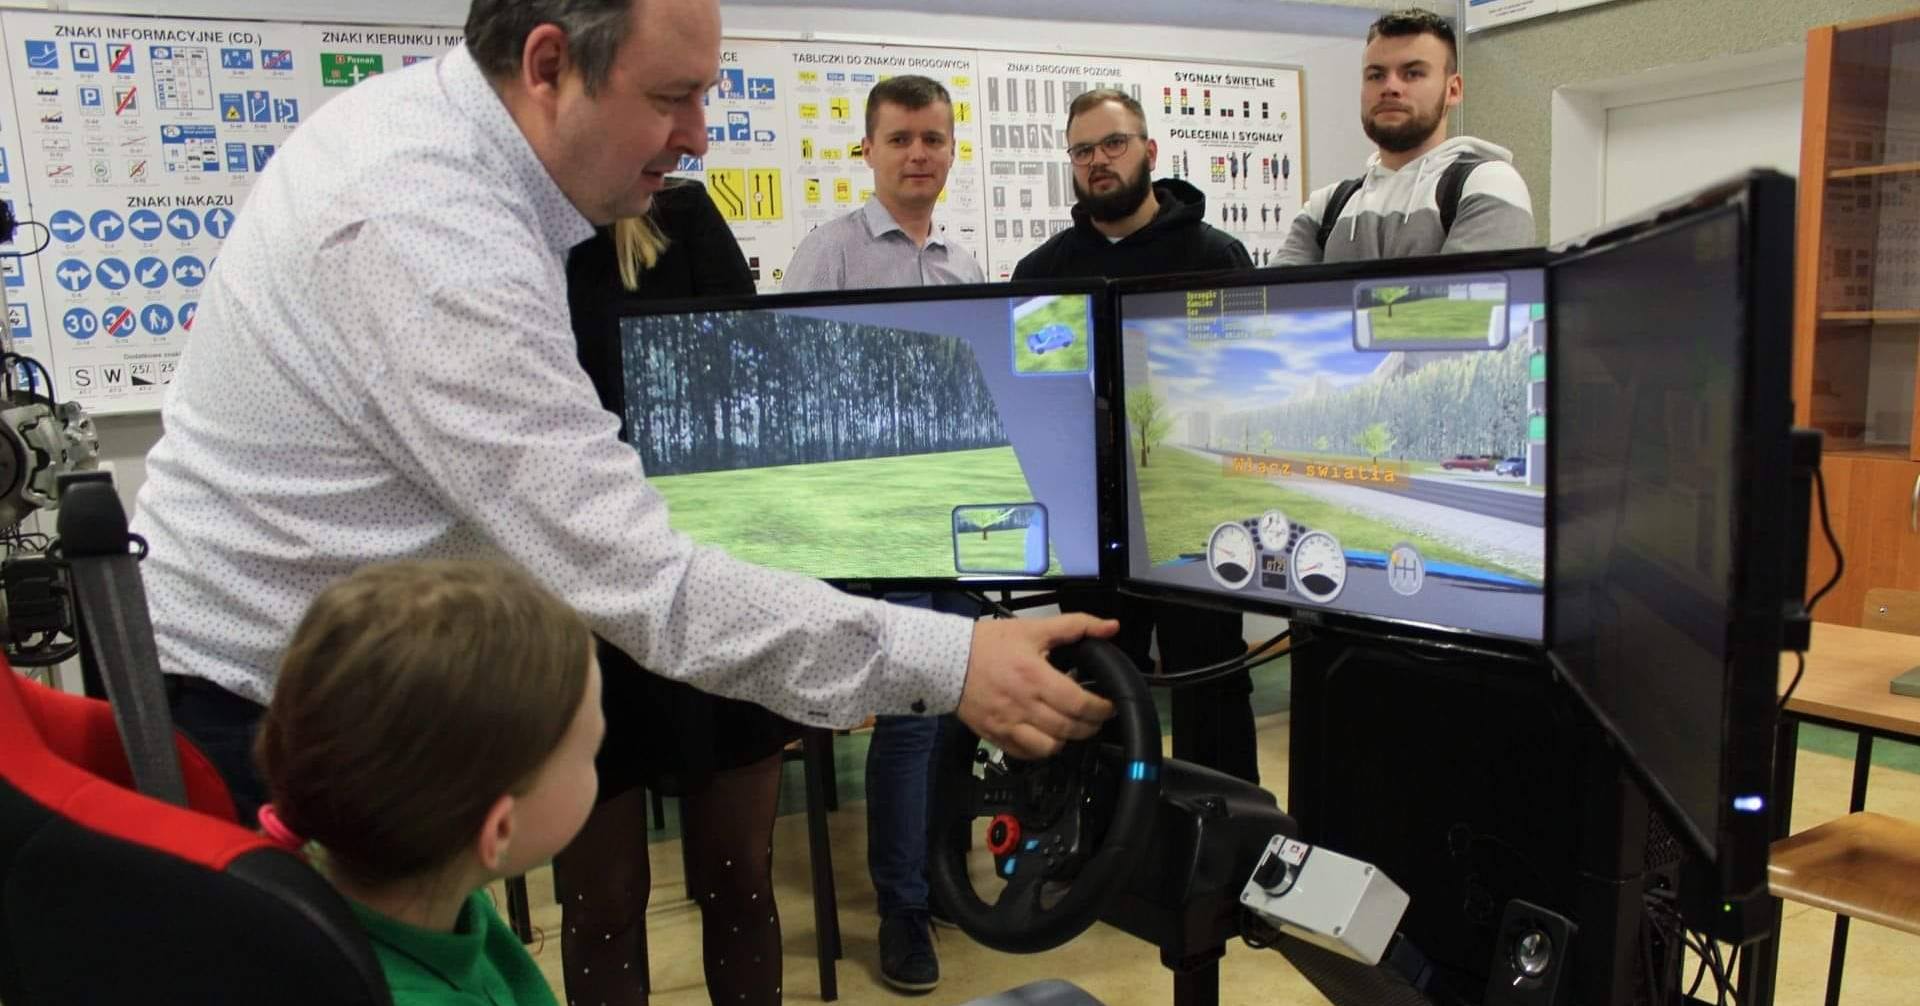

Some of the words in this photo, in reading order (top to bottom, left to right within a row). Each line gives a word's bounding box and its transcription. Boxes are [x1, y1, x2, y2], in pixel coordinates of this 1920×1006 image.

[55, 25, 102, 39] ZNAKI
[106, 26, 224, 43] INFORMACYJNE
[228, 31, 263, 47] (CD.)
[322, 31, 363, 44] ZNAKI
[366, 33, 433, 46] KIERUNKU
[792, 53, 844, 64] TABLICZKI
[847, 55, 862, 65] DO
[864, 54, 906, 67] ZNAKÓW
[908, 59, 970, 70] DROGOWYCH
[1007, 63, 1034, 73] ZNAKI
[1035, 64, 1082, 75] DROGOWE
[1083, 66, 1122, 77] POZIOME
[1174, 71, 1222, 85] SYGNAŁY
[1225, 73, 1277, 88] ŚWIETLNE
[1170, 128, 1230, 140] POLECENIA
[1239, 131, 1284, 143] SYGNAŁY
[127, 196, 171, 208] ZNAKI
[175, 194, 234, 207] NAKAZU
[65, 314, 96, 333] 30
[75, 368, 92, 388] S
[104, 368, 122, 384] W
